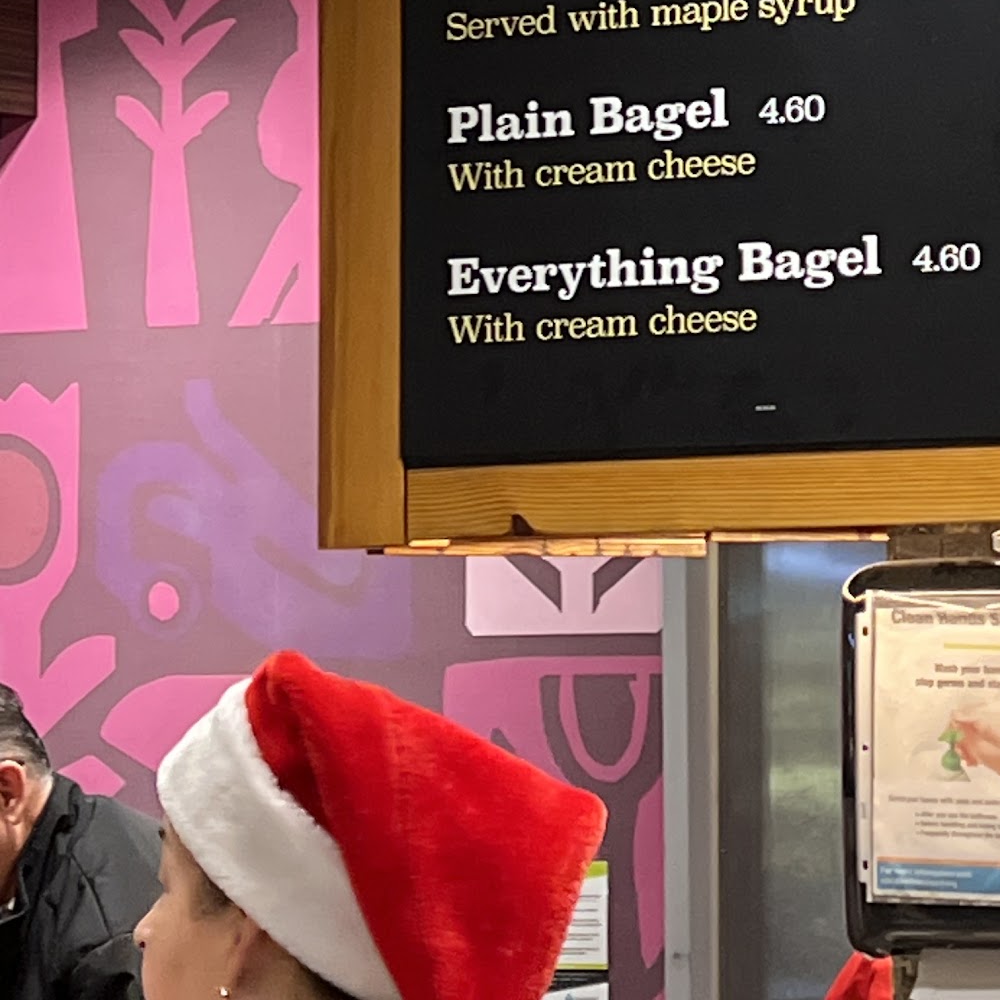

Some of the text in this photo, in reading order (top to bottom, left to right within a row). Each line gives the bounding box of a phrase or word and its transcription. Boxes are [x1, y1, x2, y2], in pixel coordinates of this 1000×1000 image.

[447, 5, 557, 40] Served
[567, 0, 640, 32] with
[447, 87, 825, 144] Plain Bagel 4.60
[447, 149, 756, 191] With cream cheese
[447, 234, 981, 300] Everything Bagel 4.60
[447, 304, 758, 343] With cream cheese
[891, 609, 933, 625] Clean
